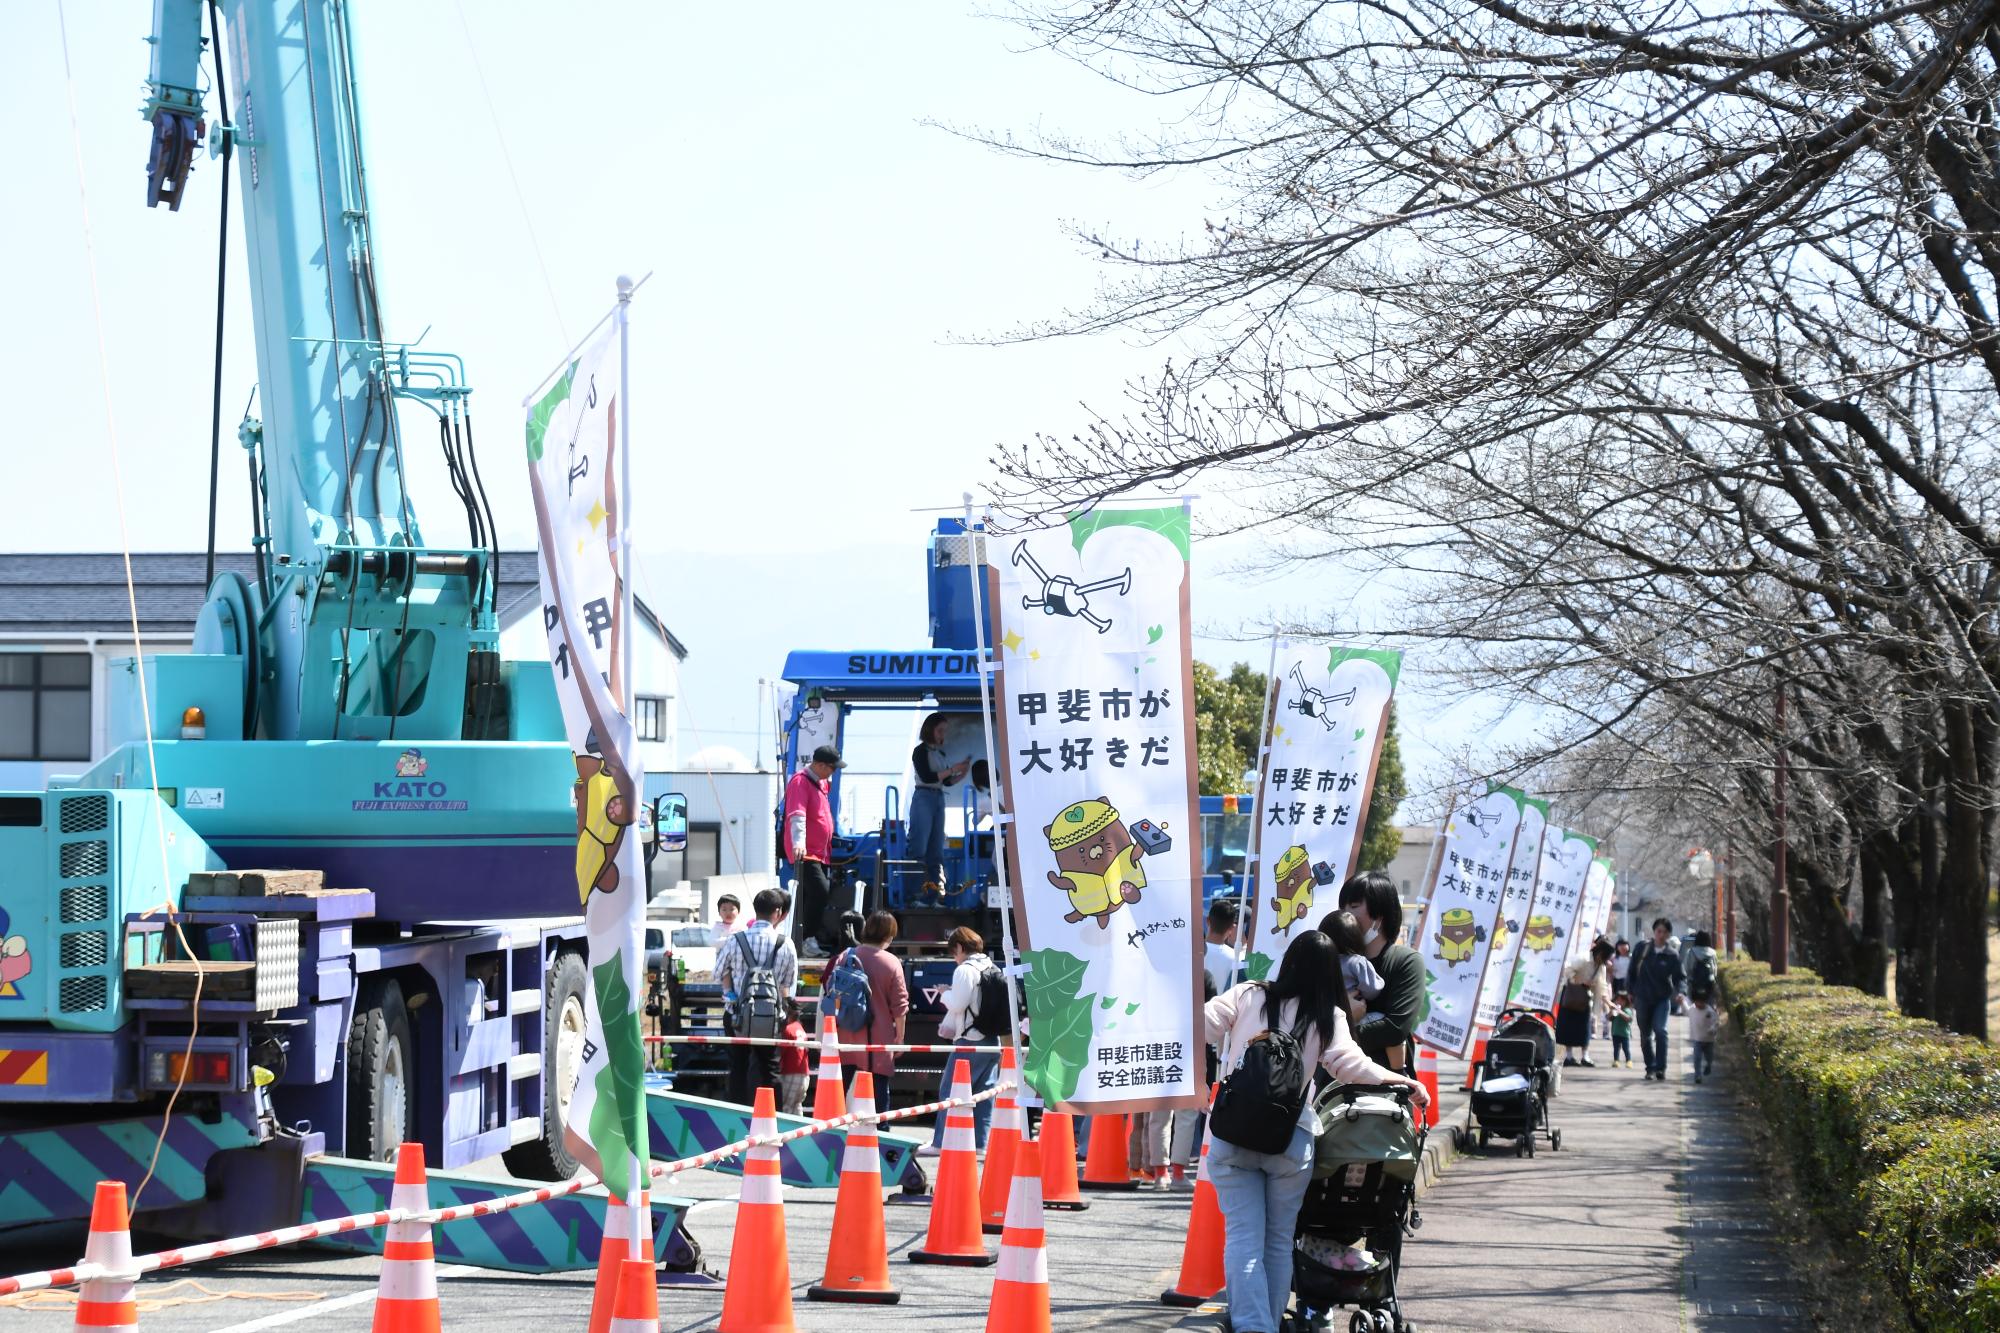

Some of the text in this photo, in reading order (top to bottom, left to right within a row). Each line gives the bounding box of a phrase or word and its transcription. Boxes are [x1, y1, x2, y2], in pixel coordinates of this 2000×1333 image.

[1018, 687, 1171, 726] 甲斐市が
[1019, 735, 1170, 776] 大好きだ
[374, 781, 447, 798] KATO
[1272, 767, 1358, 793] 甲斐市が
[354, 801, 378, 810] FUJI
[381, 801, 425, 810] EXPRESS
[1267, 801, 1351, 827] 大好きだ
[1449, 850, 1504, 882] 甲斐市が
[1442, 873, 1499, 905] 大好きだ
[1097, 1041, 1183, 1066] 甲斐市建設
[1097, 1064, 1184, 1089] 安全協議会
